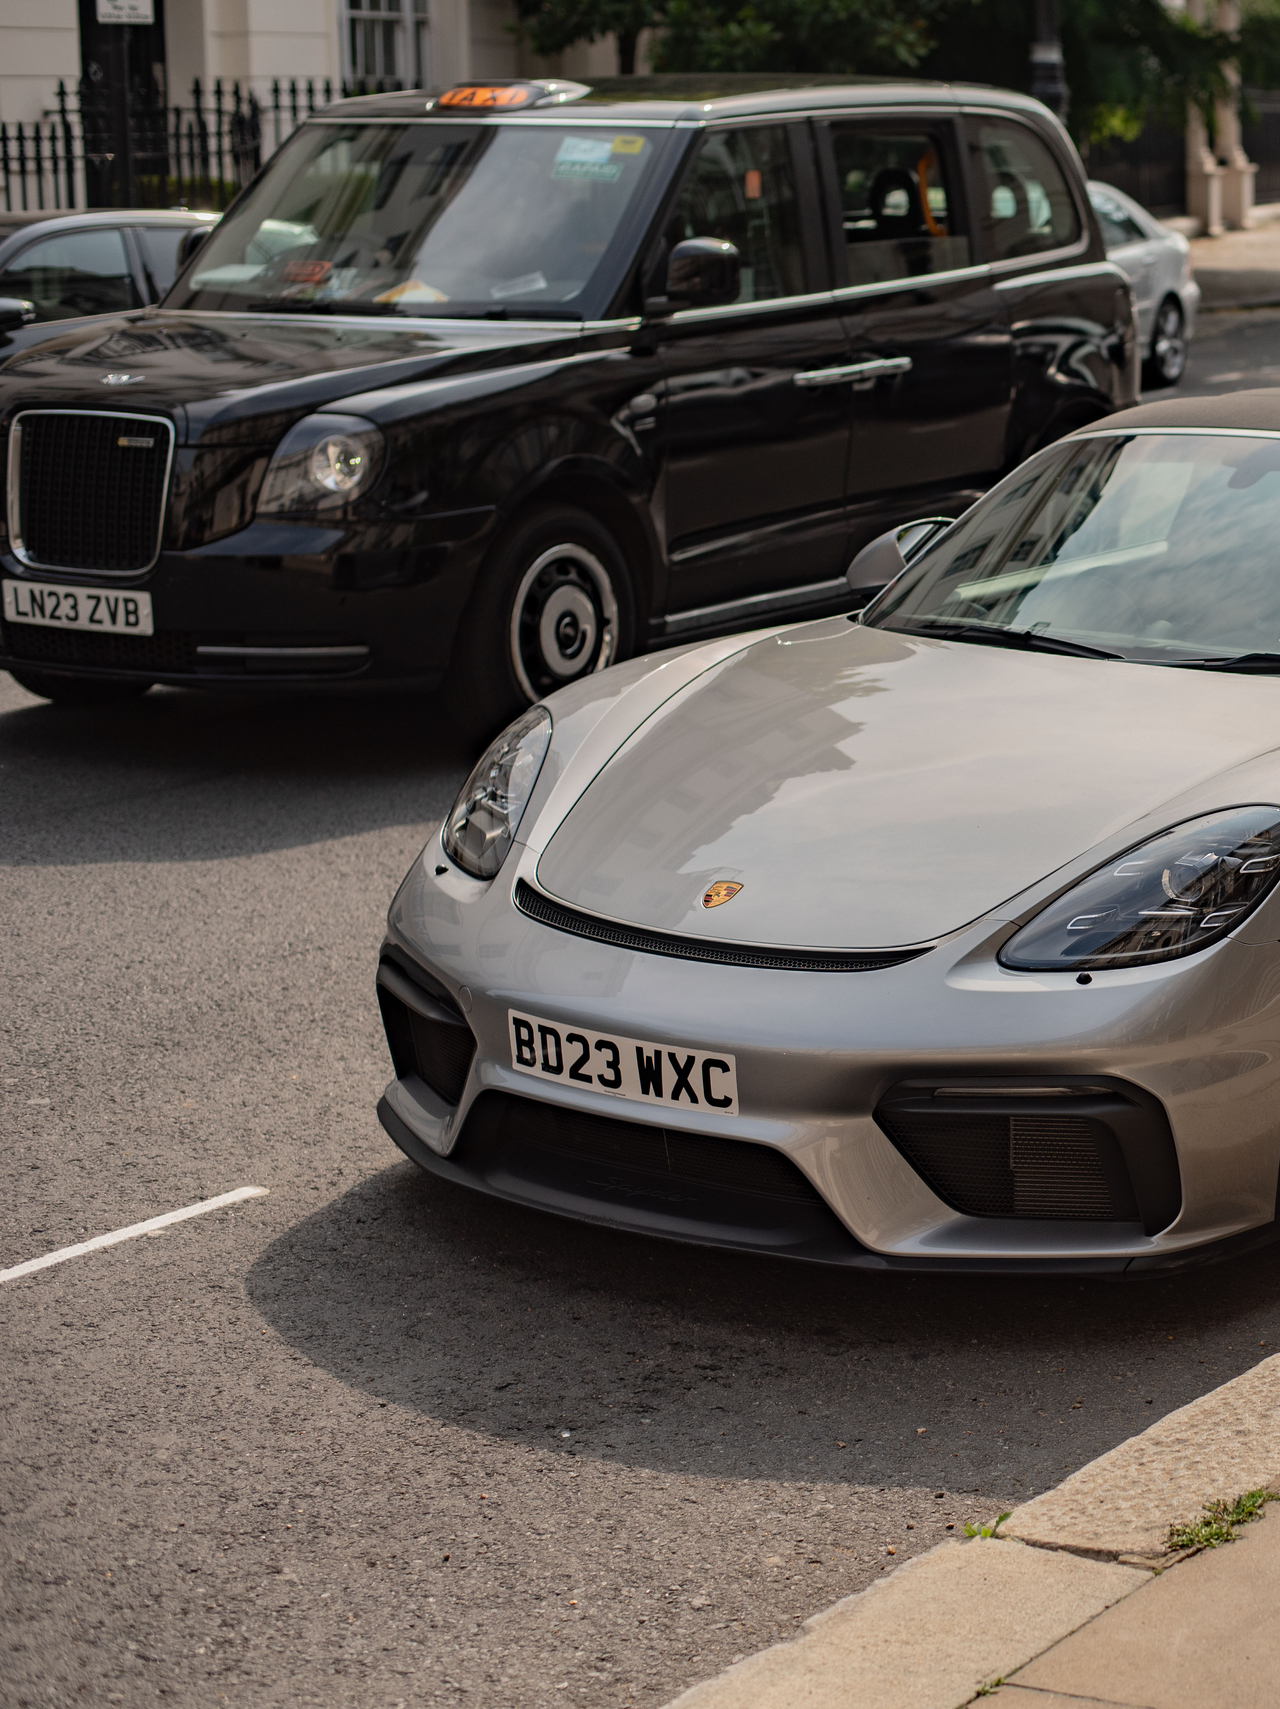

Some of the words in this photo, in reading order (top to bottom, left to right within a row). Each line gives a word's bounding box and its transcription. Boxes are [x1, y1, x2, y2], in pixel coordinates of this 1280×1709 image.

[444, 87, 521, 106] TAXI
[13, 586, 79, 622] LN23
[86, 594, 139, 627] ZVB
[512, 1016, 622, 1089] BD23
[635, 1045, 733, 1108] WXC
